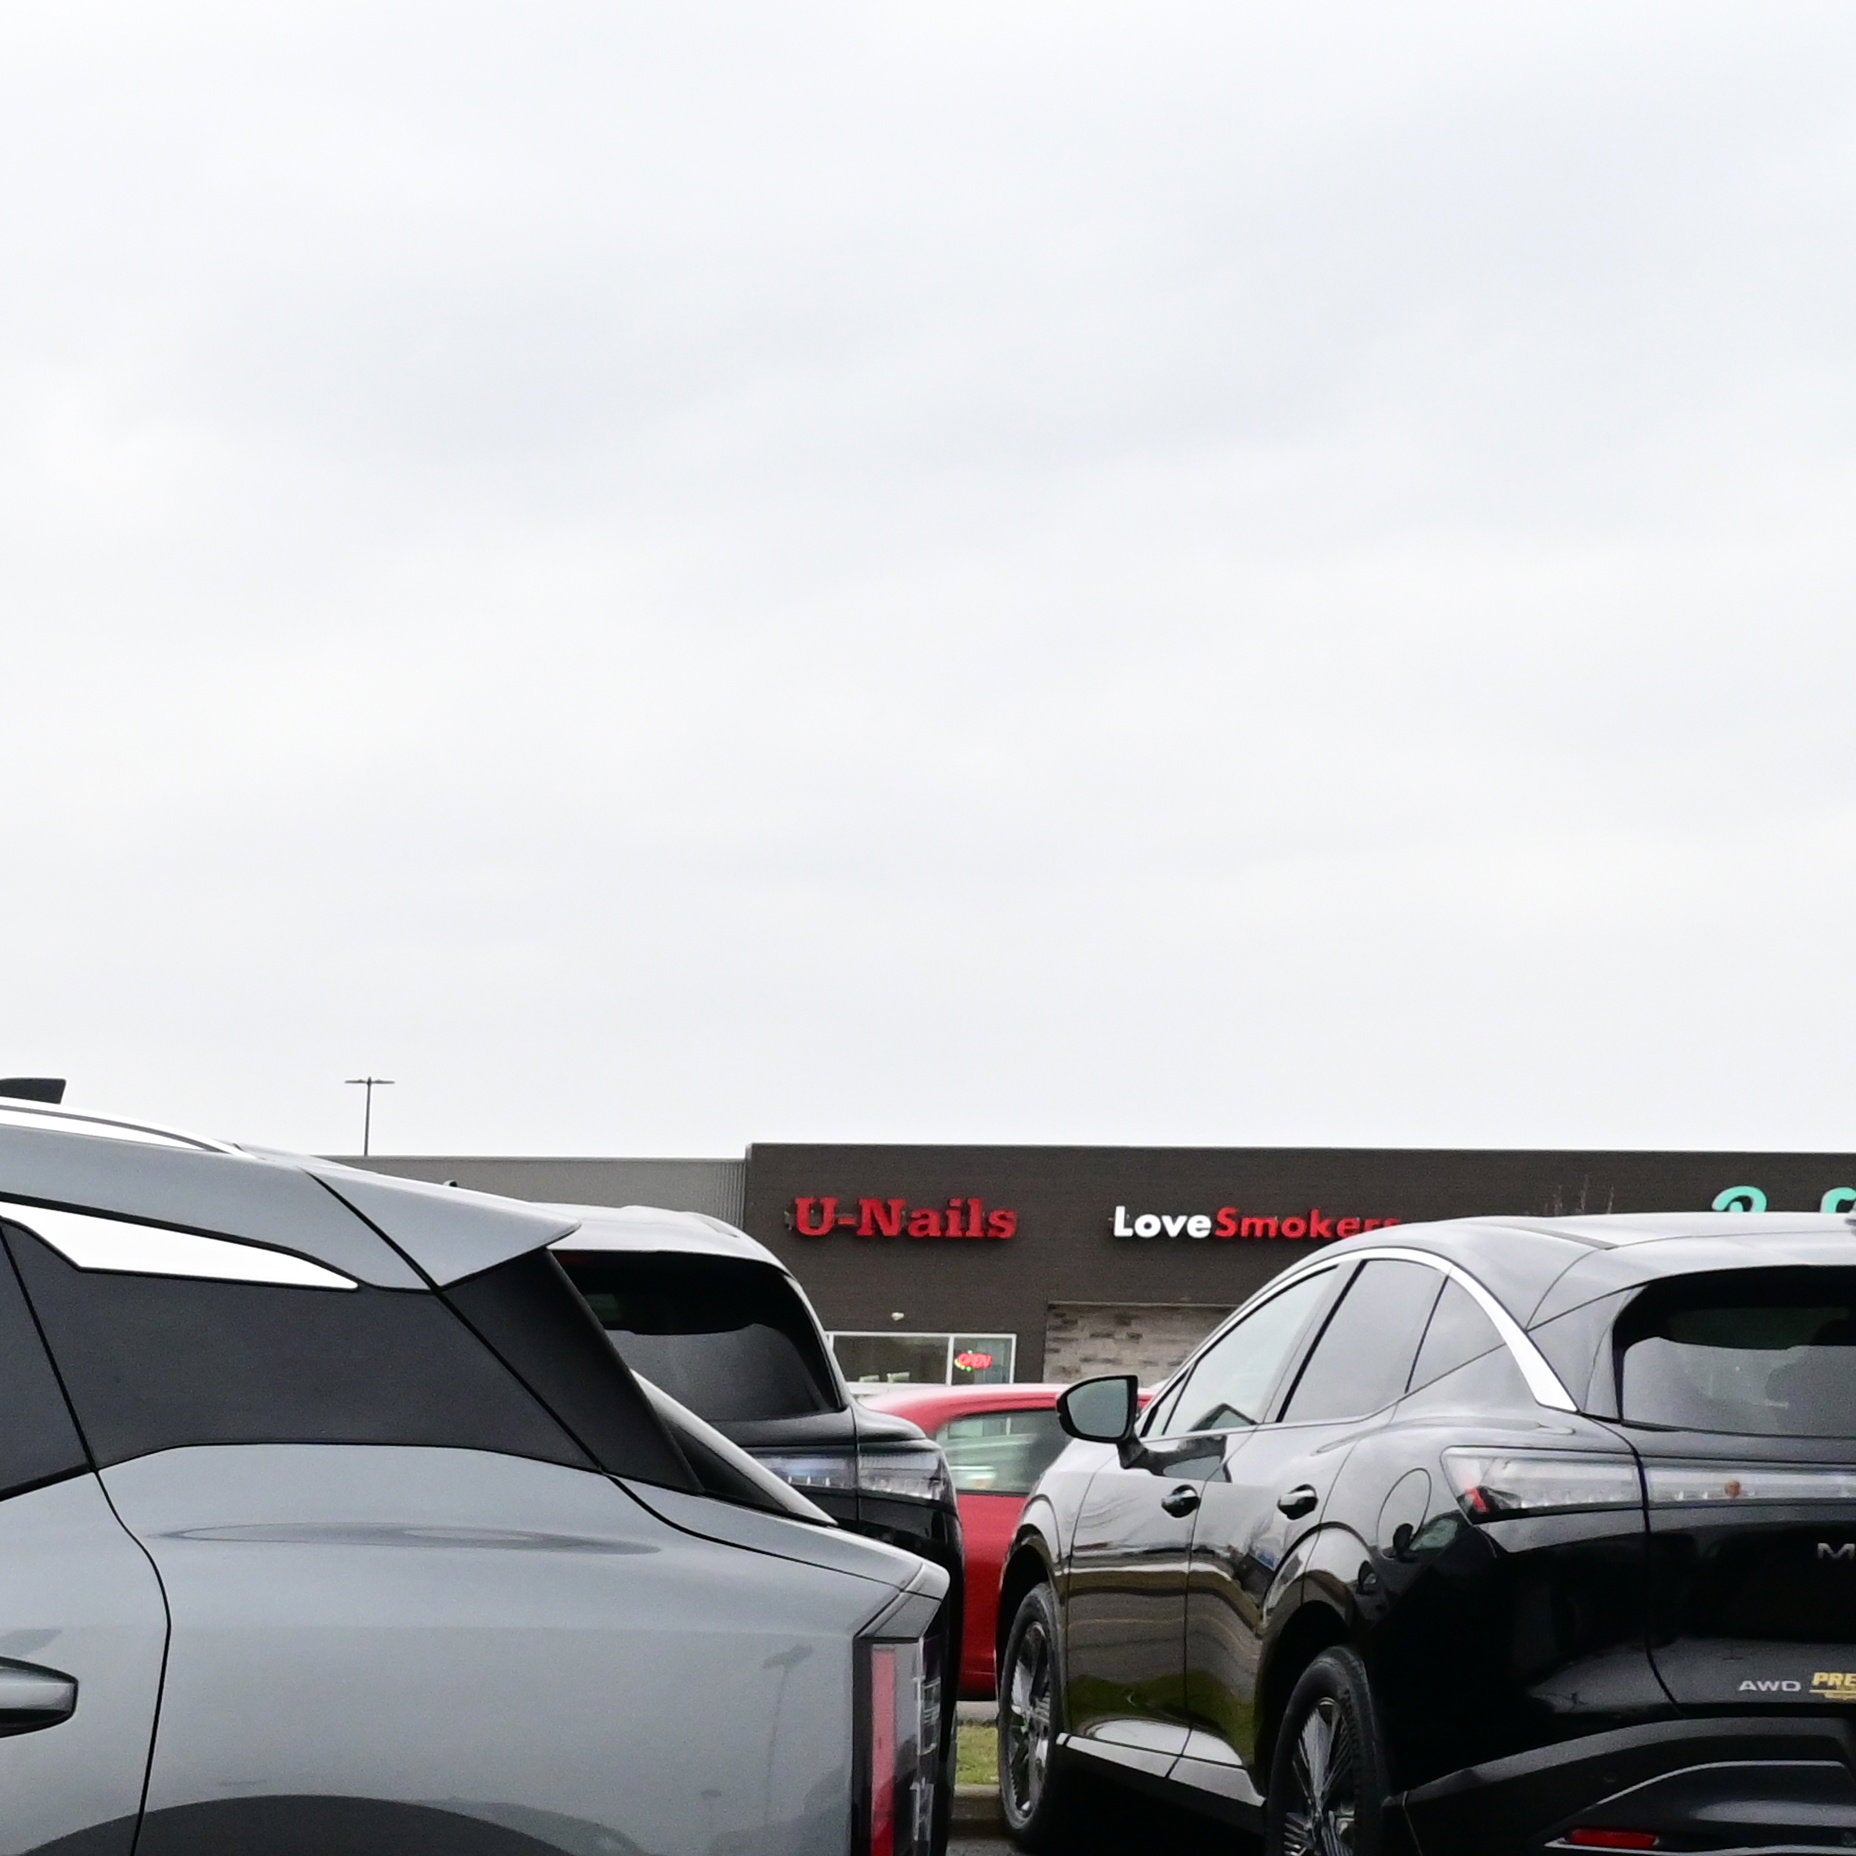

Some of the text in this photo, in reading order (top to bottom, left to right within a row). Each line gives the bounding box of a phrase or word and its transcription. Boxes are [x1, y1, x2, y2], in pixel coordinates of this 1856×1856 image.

[794, 1197, 1018, 1240] U-Nails
[958, 1353, 993, 1369] OPEN
[1738, 1680, 1802, 1692] AWD
